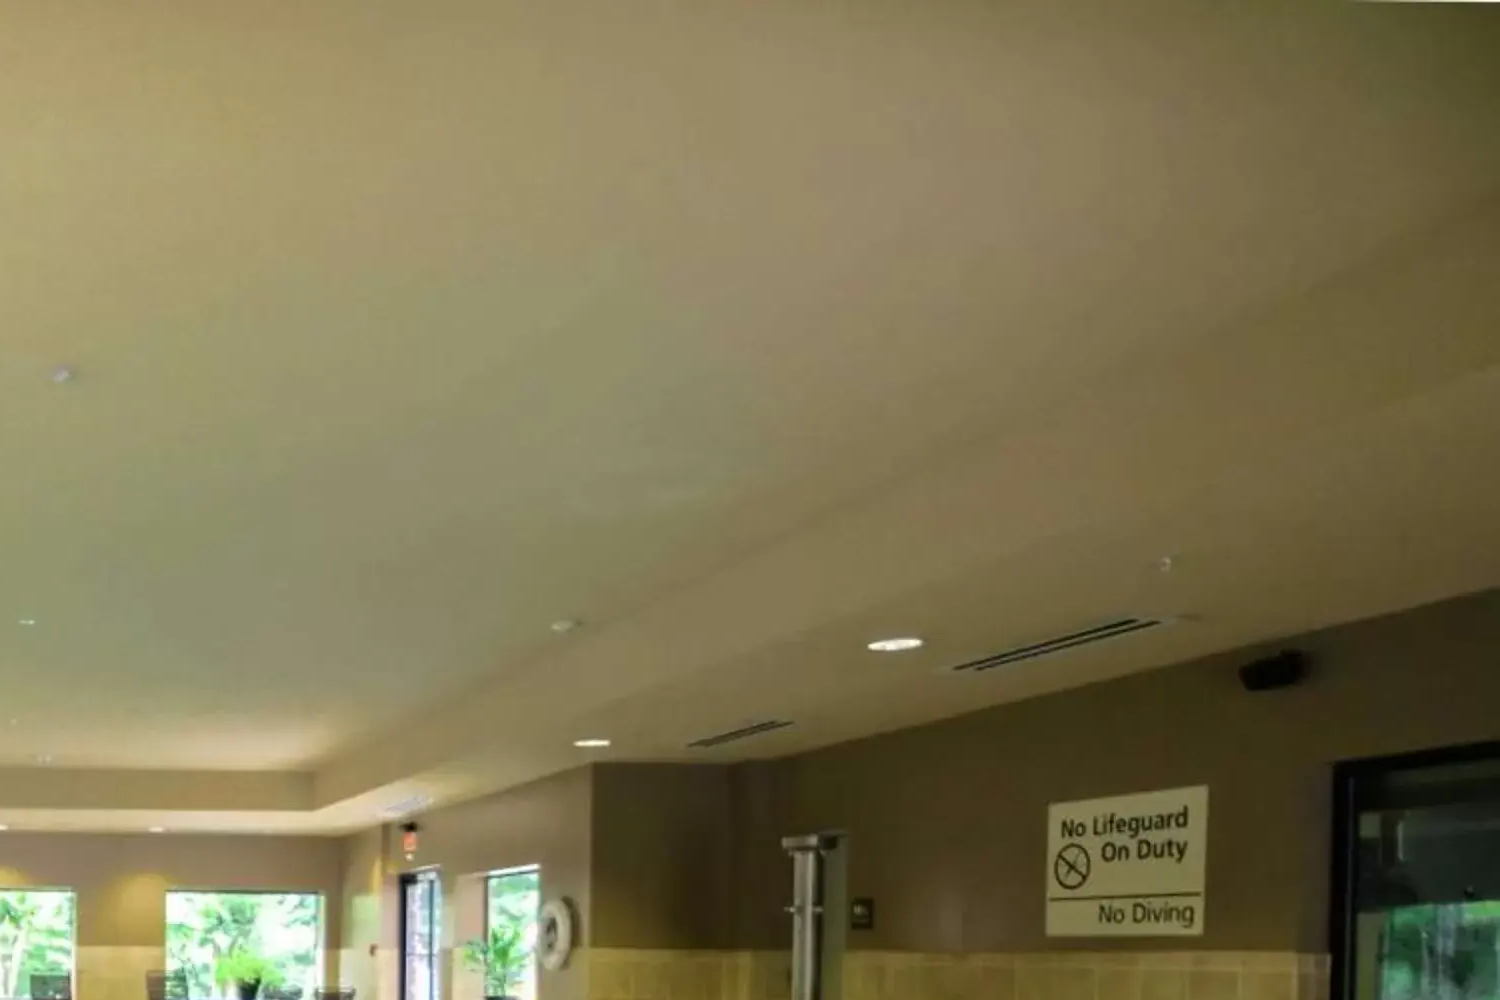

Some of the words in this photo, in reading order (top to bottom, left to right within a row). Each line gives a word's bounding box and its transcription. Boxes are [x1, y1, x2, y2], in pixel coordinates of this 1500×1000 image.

[1061, 820, 1086, 838] No
[1093, 805, 1189, 838] Lifeguard
[1101, 841, 1130, 862] On
[1137, 839, 1188, 862] Duty
[1098, 905, 1125, 924] No
[1132, 901, 1195, 928] Diving
